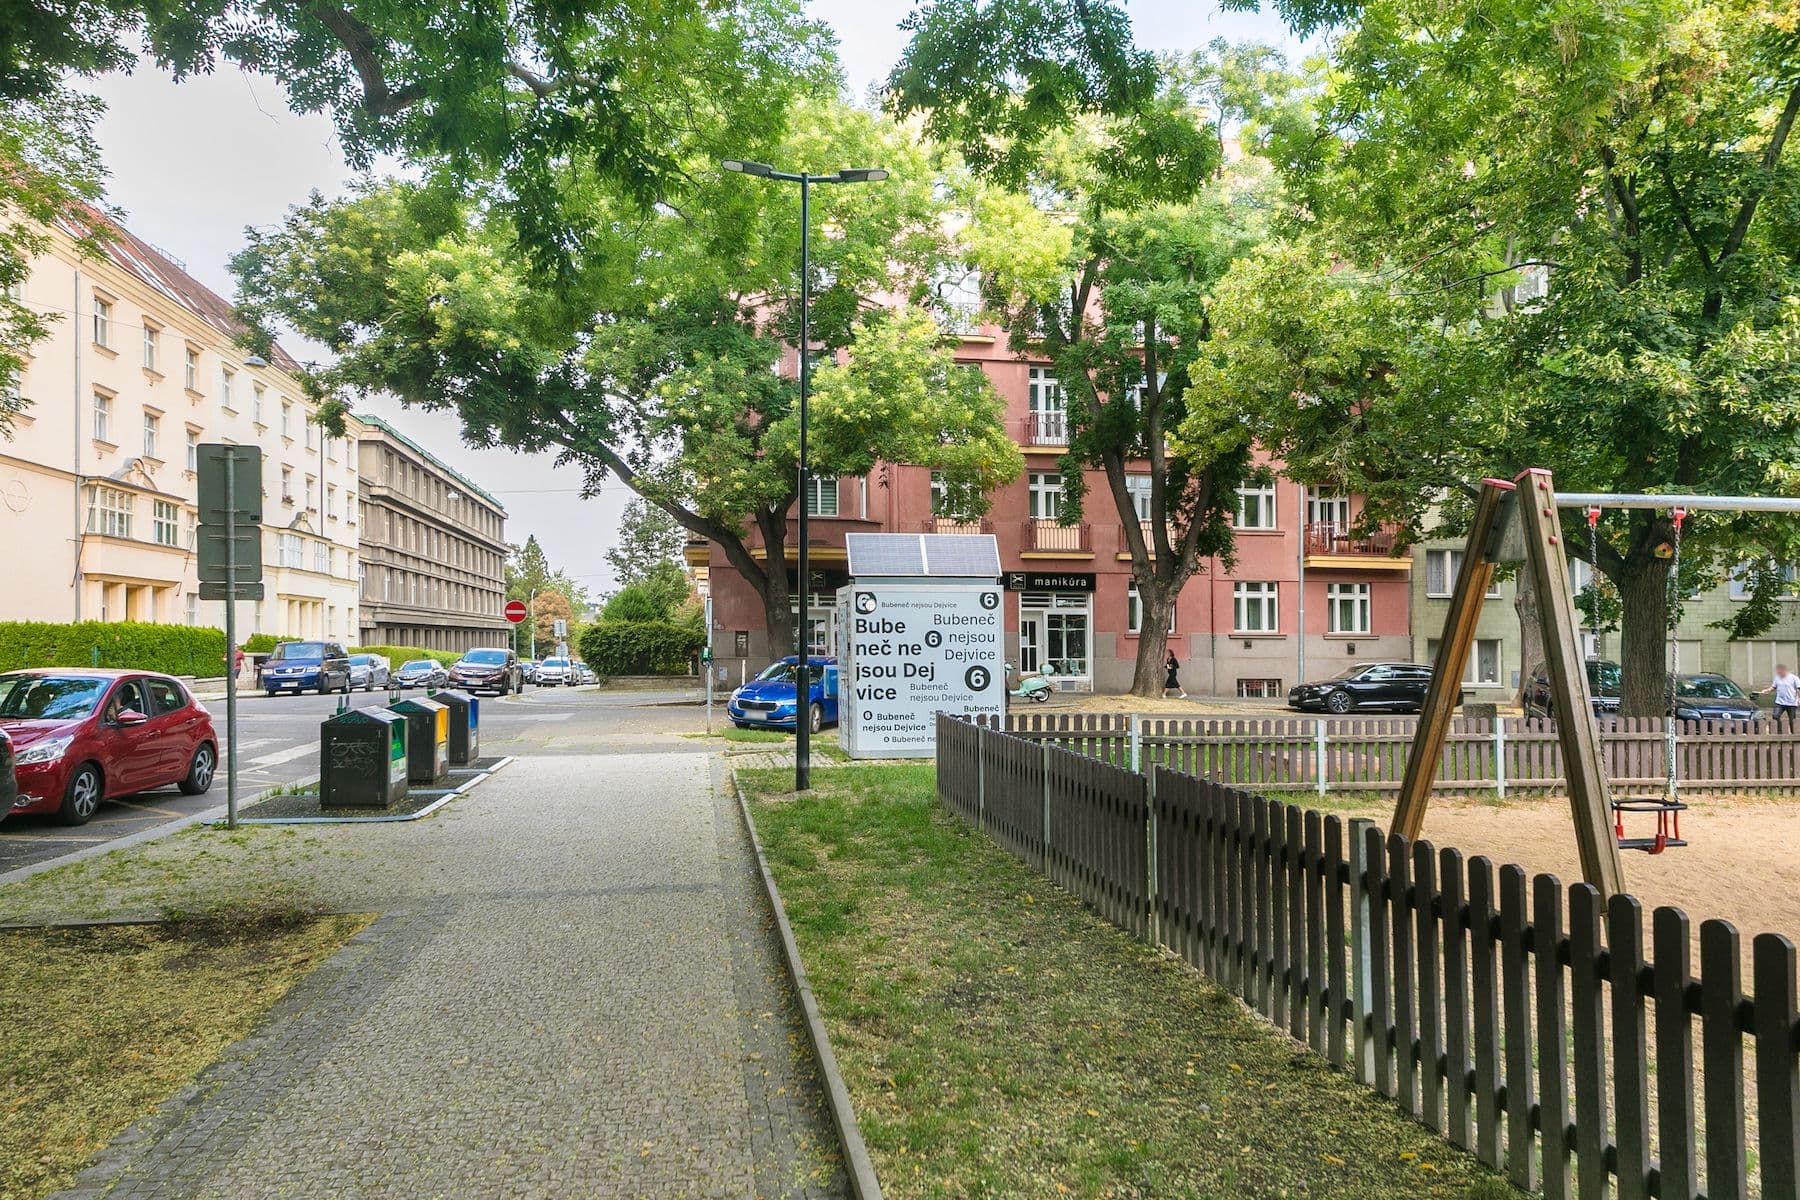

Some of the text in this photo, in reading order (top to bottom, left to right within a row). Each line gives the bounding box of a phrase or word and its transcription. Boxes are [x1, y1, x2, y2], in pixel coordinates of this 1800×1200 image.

[1035, 577, 1087, 587] manikúra
[934, 613, 995, 625] Bubeneč
[856, 618, 906, 634] Bube
[949, 631, 995, 645] nejsou
[856, 639, 922, 656] neč ne
[945, 649, 995, 663] Dejvice
[856, 662, 935, 682] jsou Dej
[856, 684, 897, 700] vice
[910, 682, 949, 691] Bubeneč
[910, 693, 973, 703] nejsou Dejvice
[877, 712, 916, 720] Bubeneč
[862, 724, 892, 733] nejsou
[894, 724, 926, 732] Dejvice
